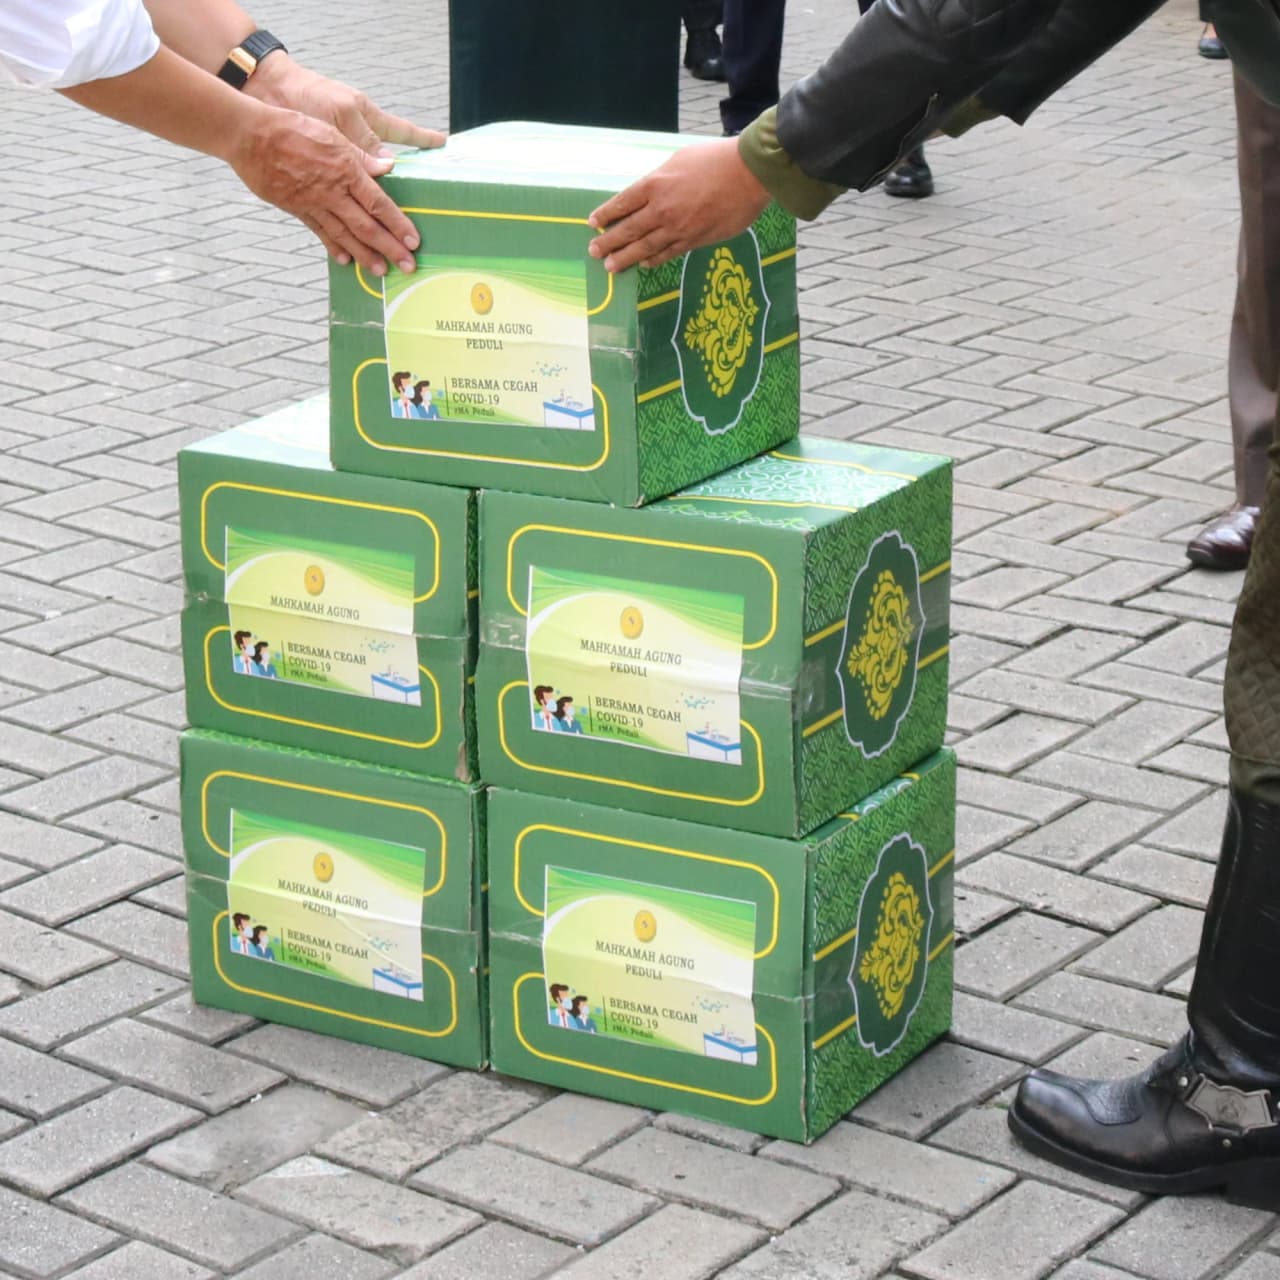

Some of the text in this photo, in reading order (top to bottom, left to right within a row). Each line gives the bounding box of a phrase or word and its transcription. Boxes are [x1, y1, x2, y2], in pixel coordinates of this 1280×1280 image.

[435, 320, 533, 335] MAHKAMAH AGUNG
[466, 338, 503, 350] PEDULI
[451, 377, 538, 392] BERSAMA CEGAH
[452, 393, 500, 405] COVID-19
[270, 595, 360, 620] MAHKAMAH AGUNG
[288, 642, 366, 665] BERSAMA CEGAH
[580, 639, 682, 665] MAHKAMAH AGUNG
[288, 657, 331, 673] COVID-19
[610, 662, 647, 677] PEDULI
[595, 696, 681, 722] BERSAMA CEGAH
[596, 711, 643, 728] COVID-19
[278, 879, 368, 910] MAHKAMAH AGUNG
[287, 929, 368, 959] BERSAMA CEGAH
[288, 943, 332, 962] COVID-19
[596, 940, 695, 970] MAHKAMAH AGUNG
[625, 964, 663, 981] PEDULI
[609, 997, 698, 1024] BERSAMA CEGAH
[610, 1011, 659, 1029] COVID-19
